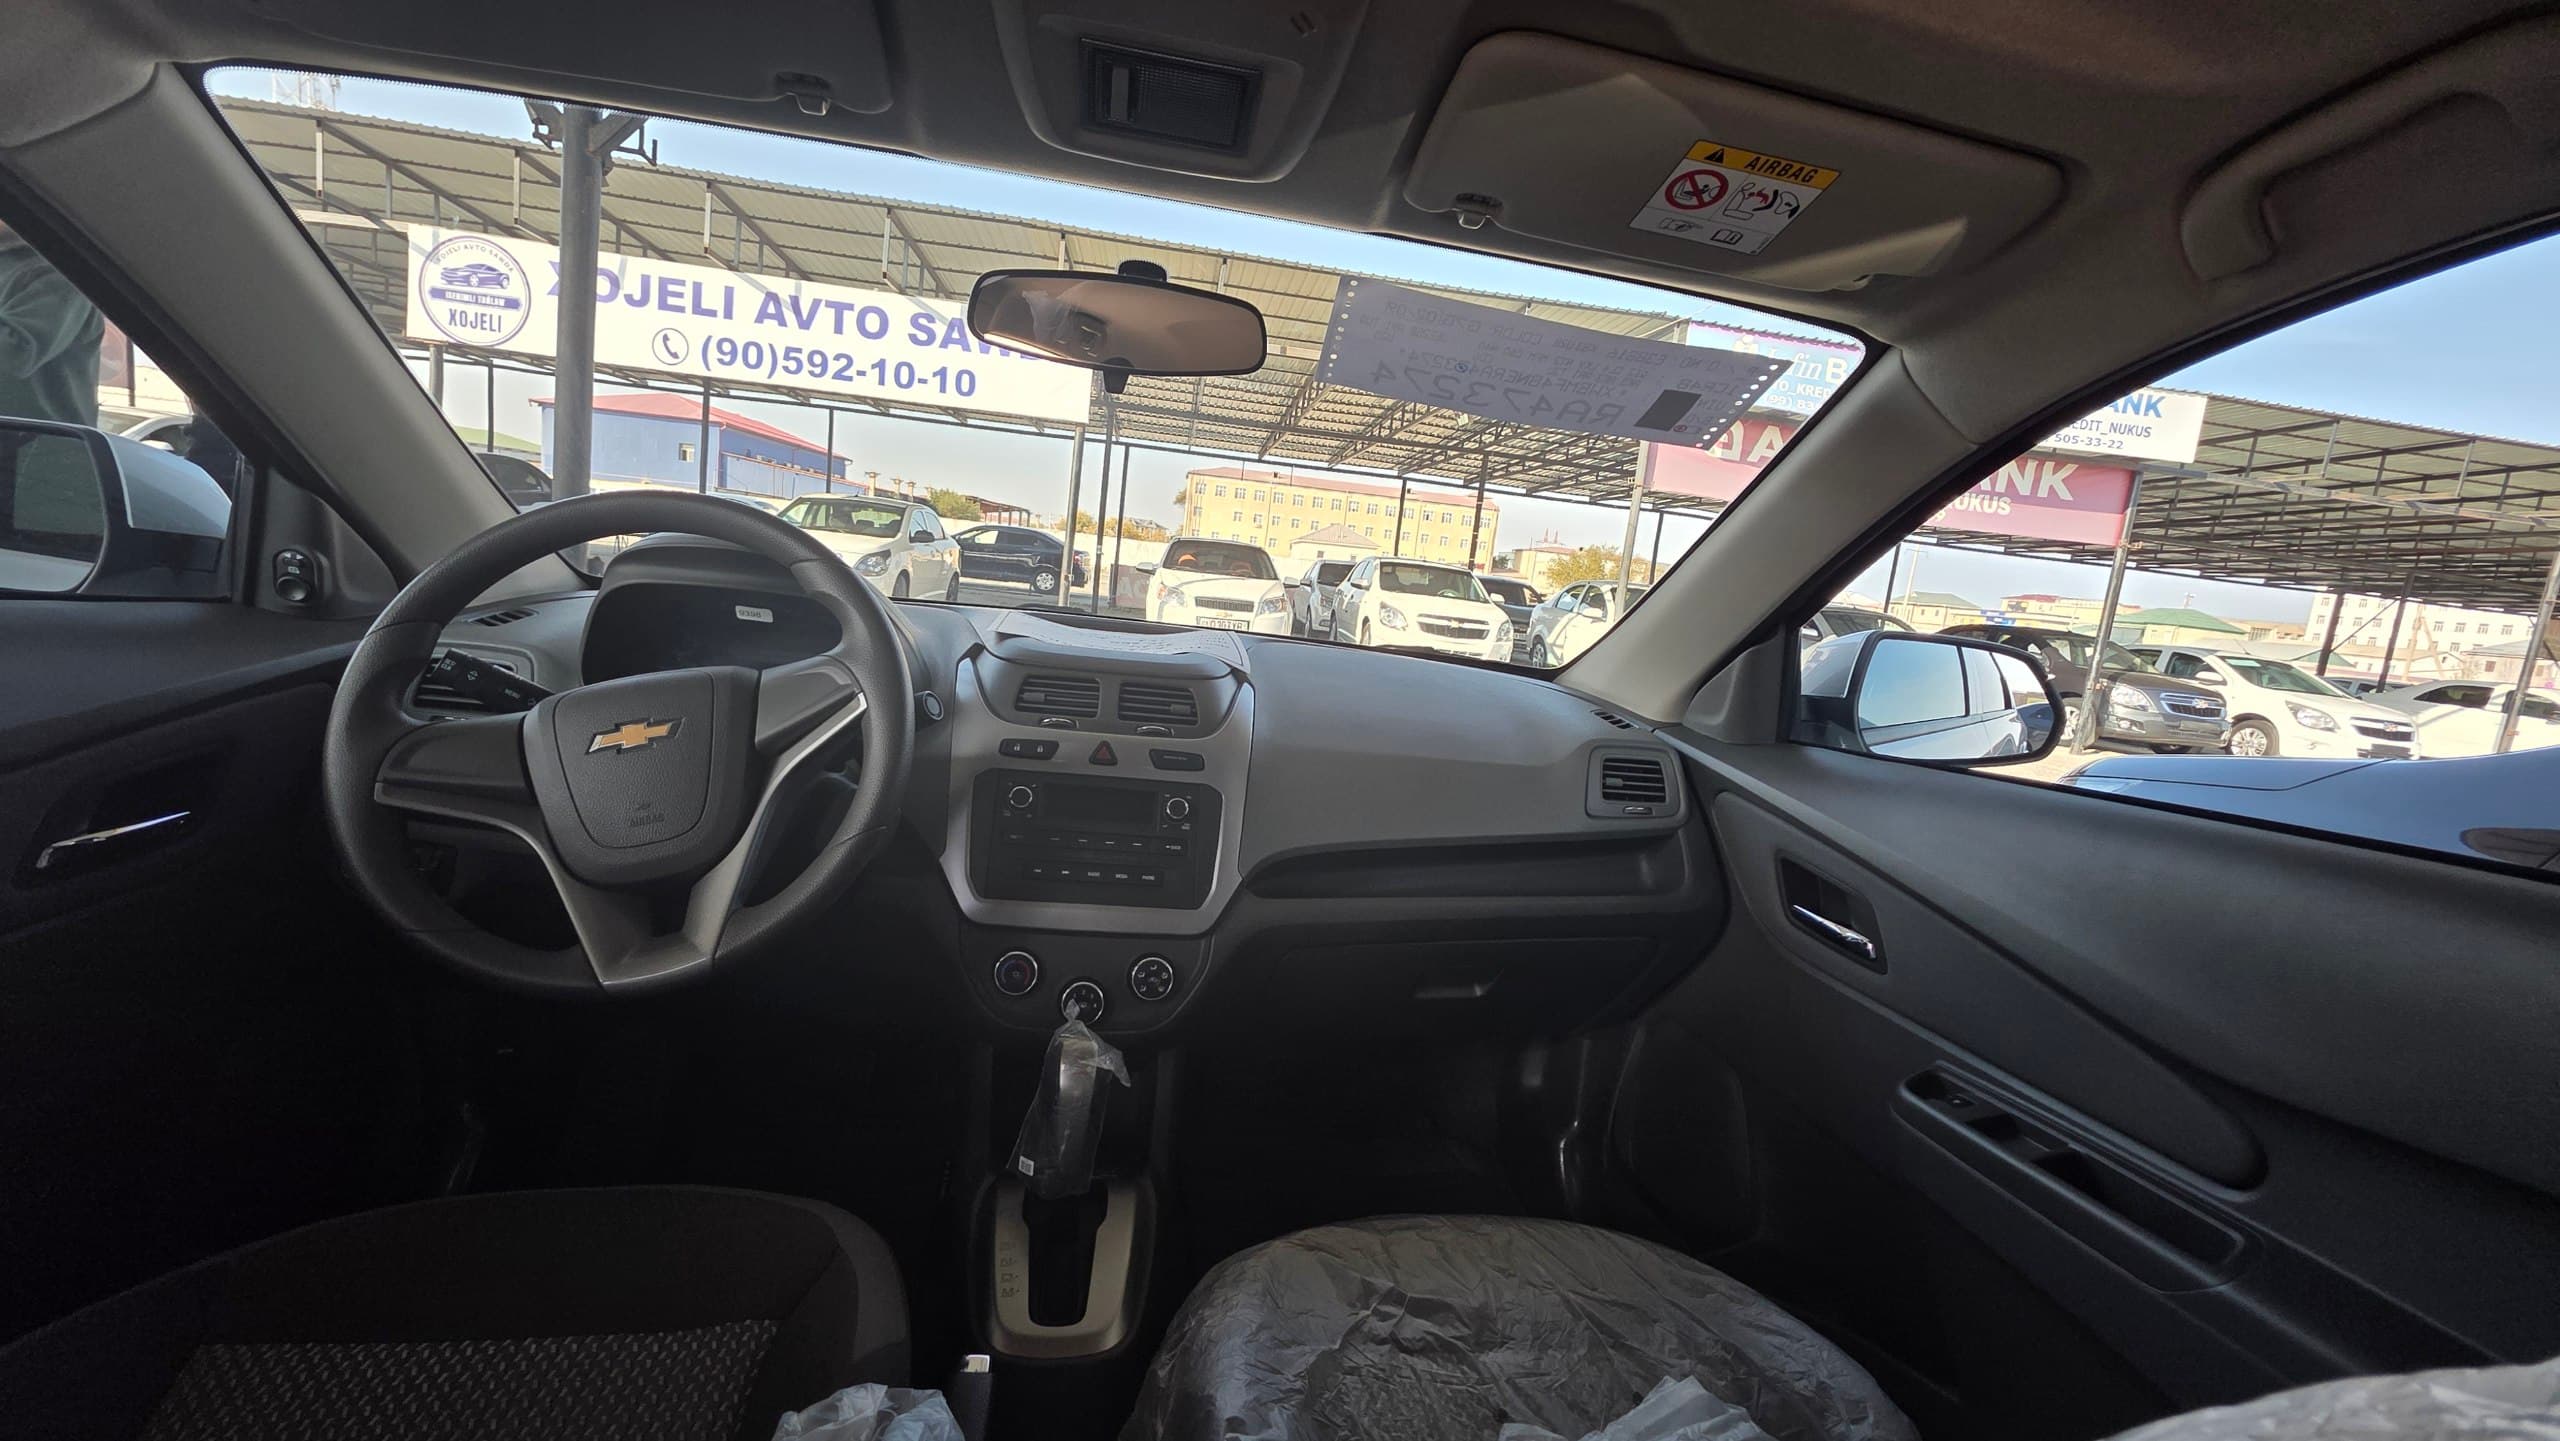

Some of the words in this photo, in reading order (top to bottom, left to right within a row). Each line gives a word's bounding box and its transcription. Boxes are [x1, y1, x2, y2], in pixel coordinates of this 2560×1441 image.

[1744, 155, 1820, 183] AIRBAG
[464, 244, 487, 253] AVTO
[448, 308, 502, 333] XOJELI
[754, 291, 890, 340] AVTO
[907, 312, 1041, 361] SA
[701, 335, 977, 397] (90)592-10-10
[2066, 418, 2153, 439] EDIT_NUKUS
[2054, 433, 2124, 450] 505-33-22
[1950, 492, 2012, 516] UKUS
